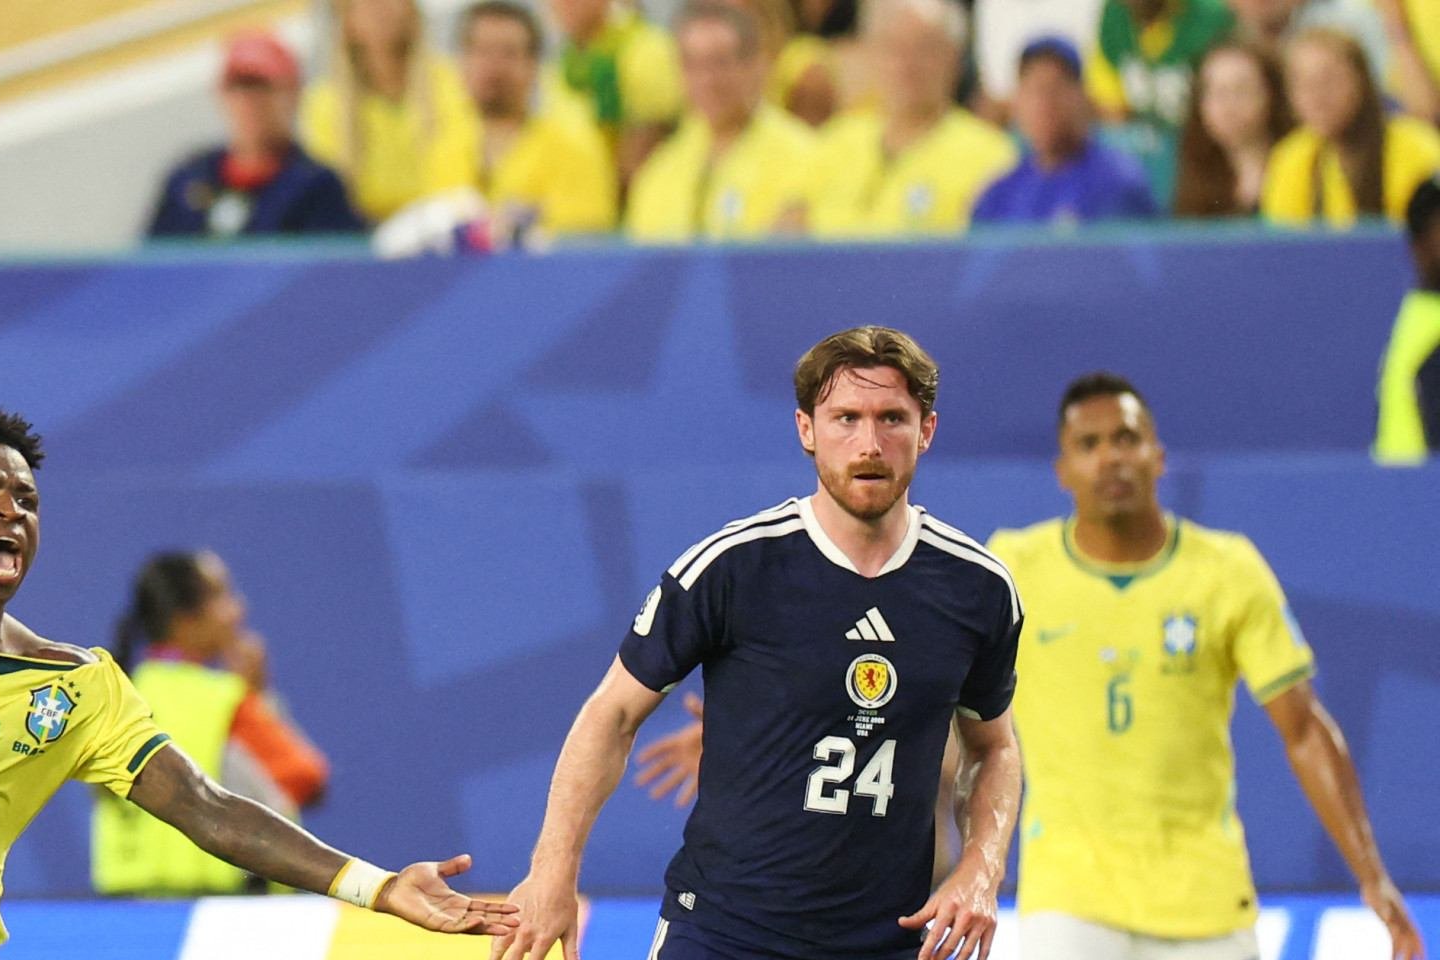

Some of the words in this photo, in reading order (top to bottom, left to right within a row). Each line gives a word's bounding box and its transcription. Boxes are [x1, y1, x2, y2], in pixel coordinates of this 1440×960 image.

[40, 706, 59, 718] CBF
[1107, 672, 1134, 735] 6
[12, 740, 46, 756] BRA
[803, 735, 897, 817] 24
